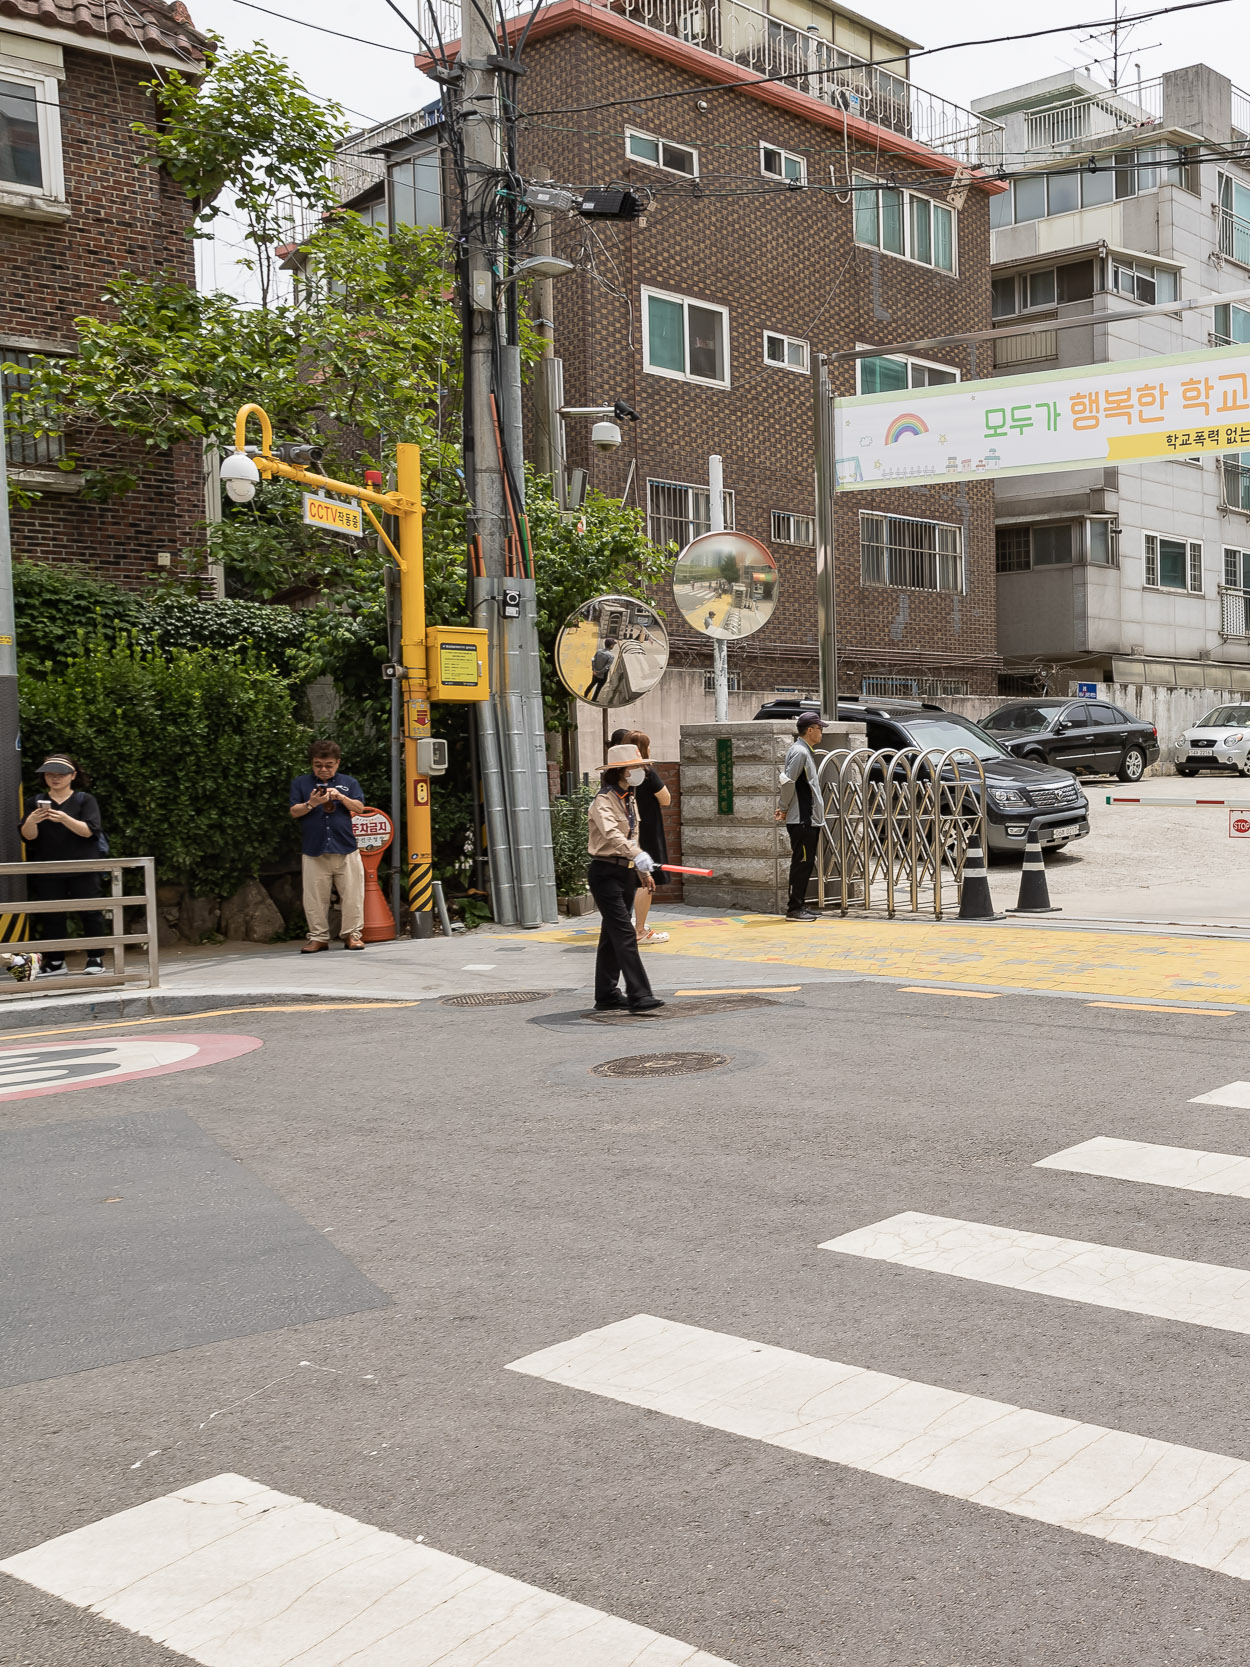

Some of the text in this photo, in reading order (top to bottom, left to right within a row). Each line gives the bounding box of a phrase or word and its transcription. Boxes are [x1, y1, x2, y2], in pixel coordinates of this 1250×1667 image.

[984, 401, 1061, 438] 모두가
[1069, 383, 1169, 431] 행복한
[1180, 373, 1250, 417] 학교
[1166, 429, 1220, 450] 학교폭력
[1233, 822, 1250, 830] STOP
